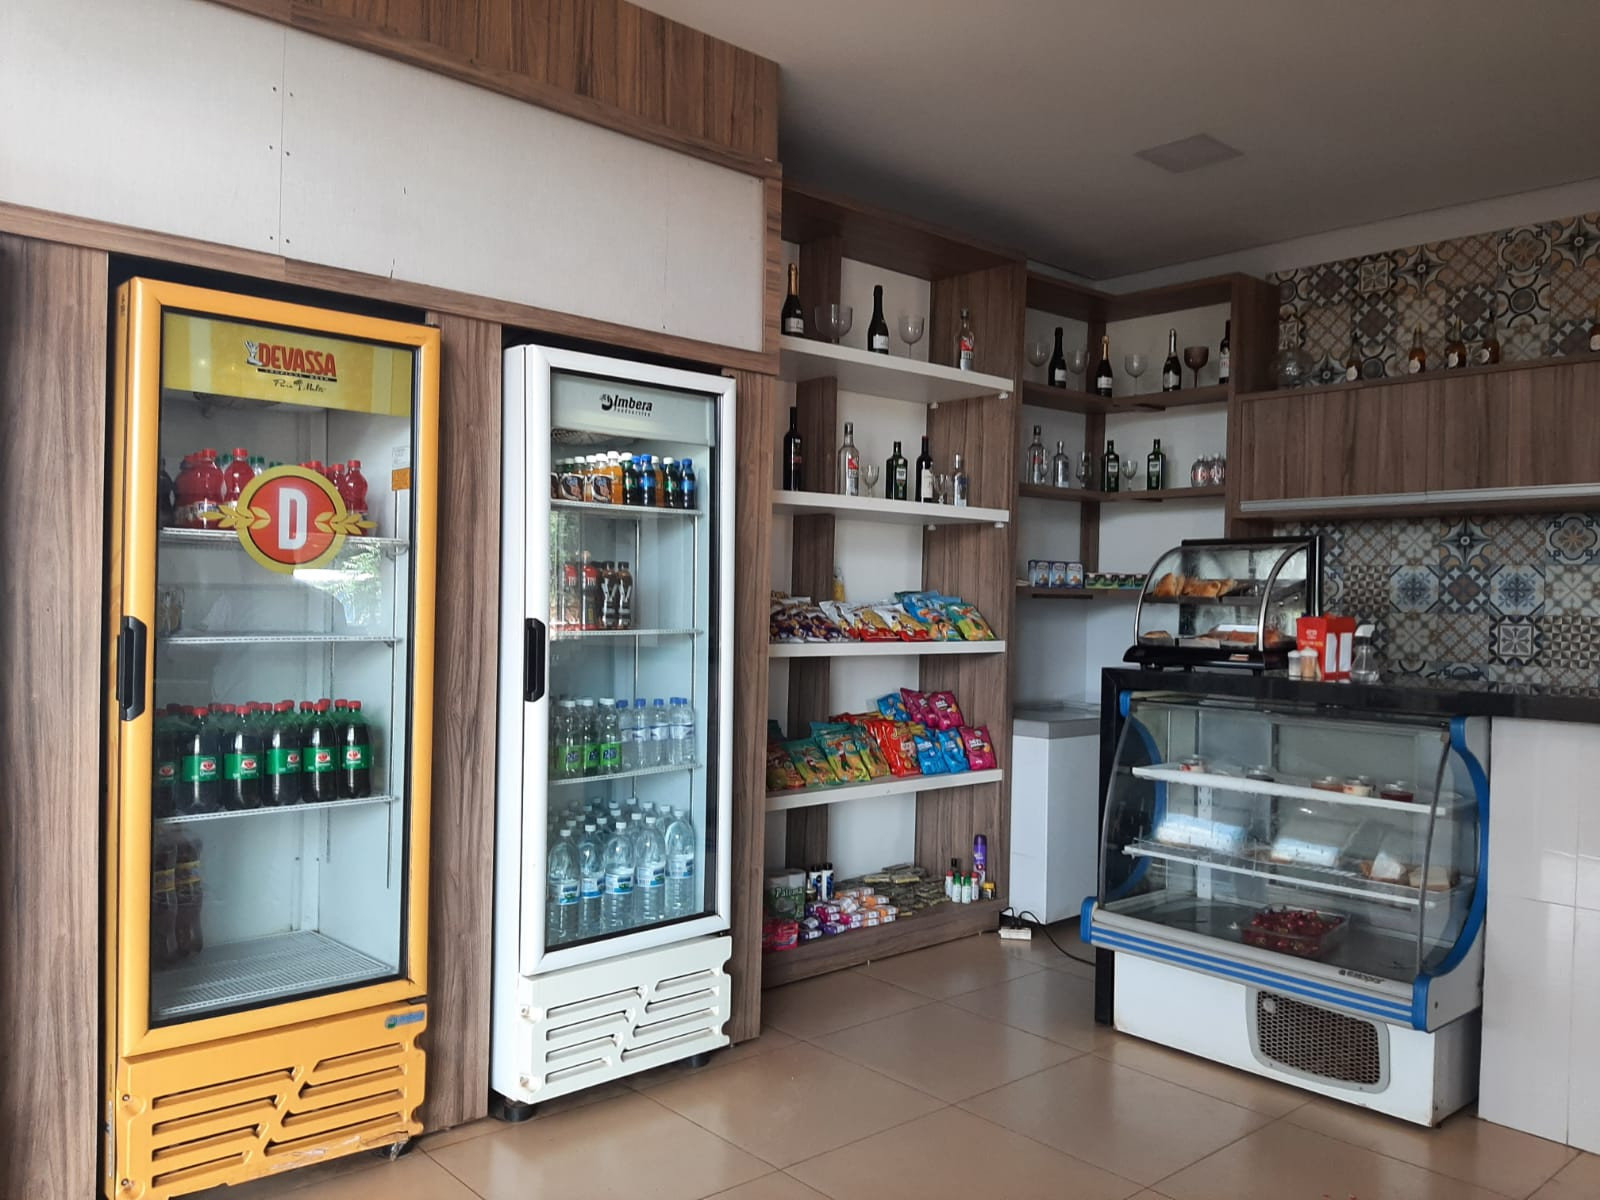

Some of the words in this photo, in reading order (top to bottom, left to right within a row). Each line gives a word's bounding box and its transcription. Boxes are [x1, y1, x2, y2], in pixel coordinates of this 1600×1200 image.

[258, 343, 336, 377] DEVASSA
[614, 394, 653, 411] Imbera
[278, 487, 308, 550] D
